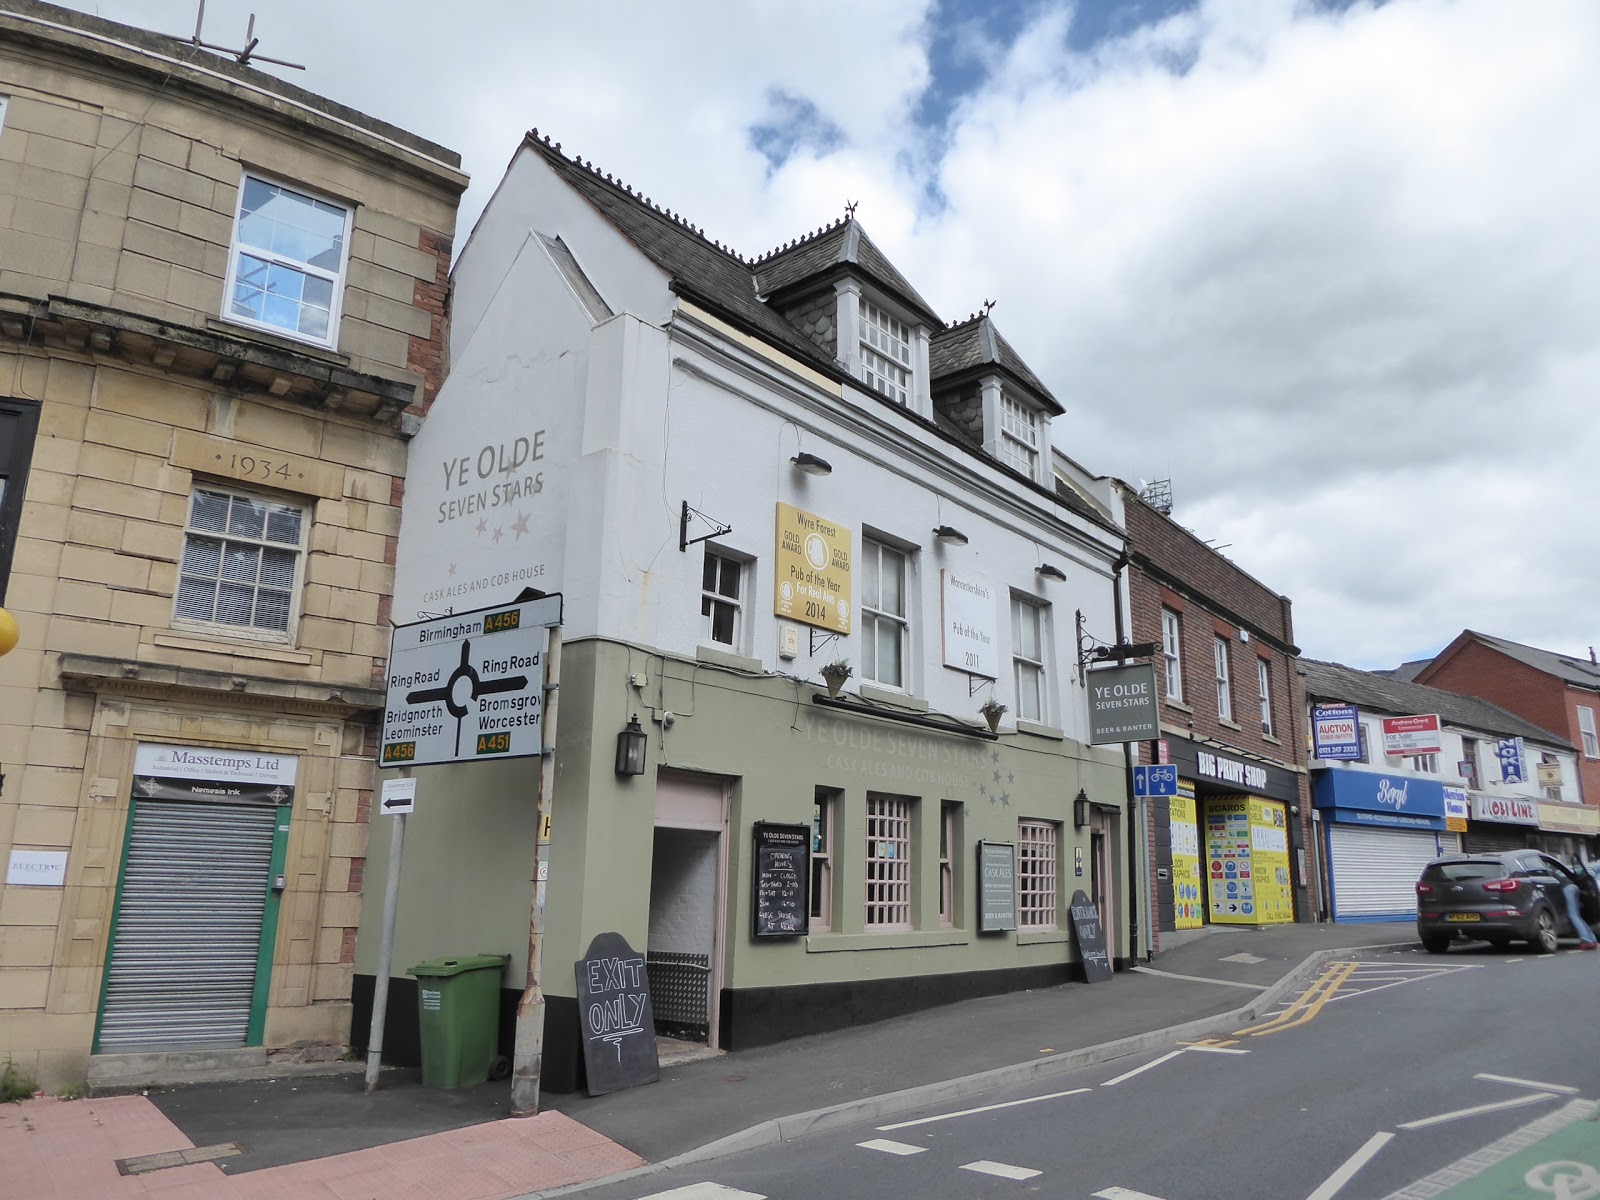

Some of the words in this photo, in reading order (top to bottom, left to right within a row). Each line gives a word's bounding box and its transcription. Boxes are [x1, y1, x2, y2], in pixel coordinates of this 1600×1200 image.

[231, 454, 291, 480] 1934
[443, 457, 470, 491] YE
[477, 429, 545, 479] OLDE
[438, 491, 487, 523] SEVEN
[491, 472, 543, 507] STARS
[797, 512, 814, 530] Wyre
[816, 520, 836, 538] Forest
[784, 530, 800, 543] GOLD
[781, 540, 802, 555] AWARD
[834, 548, 848, 561] GOLD
[832, 558, 849, 572] AWARD
[423, 589, 445, 603] CASK
[447, 583, 467, 597] ALES
[470, 578, 488, 592] AND
[491, 572, 510, 587] COB
[512, 564, 545, 582] HOUSE
[790, 565, 805, 581] Pub
[806, 572, 813, 583] of
[814, 574, 825, 588] the
[826, 576, 841, 593] Year
[796, 582, 807, 595] For
[809, 585, 822, 599] Real
[805, 600, 826, 620] 2014
[419, 620, 482, 643] Birmingham
[953, 622, 963, 636] Pub
[964, 626, 970, 637] of
[971, 627, 979, 641] the
[980, 630, 991, 645] Year
[482, 660, 508, 674] Ring
[510, 652, 539, 669] Road
[965, 651, 980, 668] 2011
[390, 675, 412, 689] Ring
[414, 669, 440, 685] Road
[1095, 686, 1110, 698] YE
[1113, 683, 1148, 697] OLDE
[1096, 701, 1121, 710] SEVEN
[1123, 697, 1149, 707] STARS
[1315, 709, 1353, 717] Cottons
[386, 705, 443, 725] Bridgnorth
[479, 712, 540, 730] Worcester
[385, 724, 443, 741] Leominster
[1122, 724, 1152, 732] BANTER
[1319, 724, 1353, 734] AUCTION
[804, 716, 827, 742] YE
[833, 719, 881, 752] OLDE
[887, 730, 938, 761] SEVEN
[943, 742, 988, 769] STARS
[171, 751, 251, 770] Masstemps
[255, 757, 279, 770] Ltd
[184, 766, 200, 774] Office
[1499, 738, 1523, 783] NOKIA
[1198, 752, 1216, 776] BIG
[1217, 756, 1244, 783] PRINT
[1245, 764, 1267, 789] SHOP
[191, 786, 226, 795] Nemesis
[227, 788, 241, 796] Ink
[1208, 804, 1245, 813] BOARDS
[587, 957, 643, 994] EXIT
[589, 993, 646, 1034] ONLY
